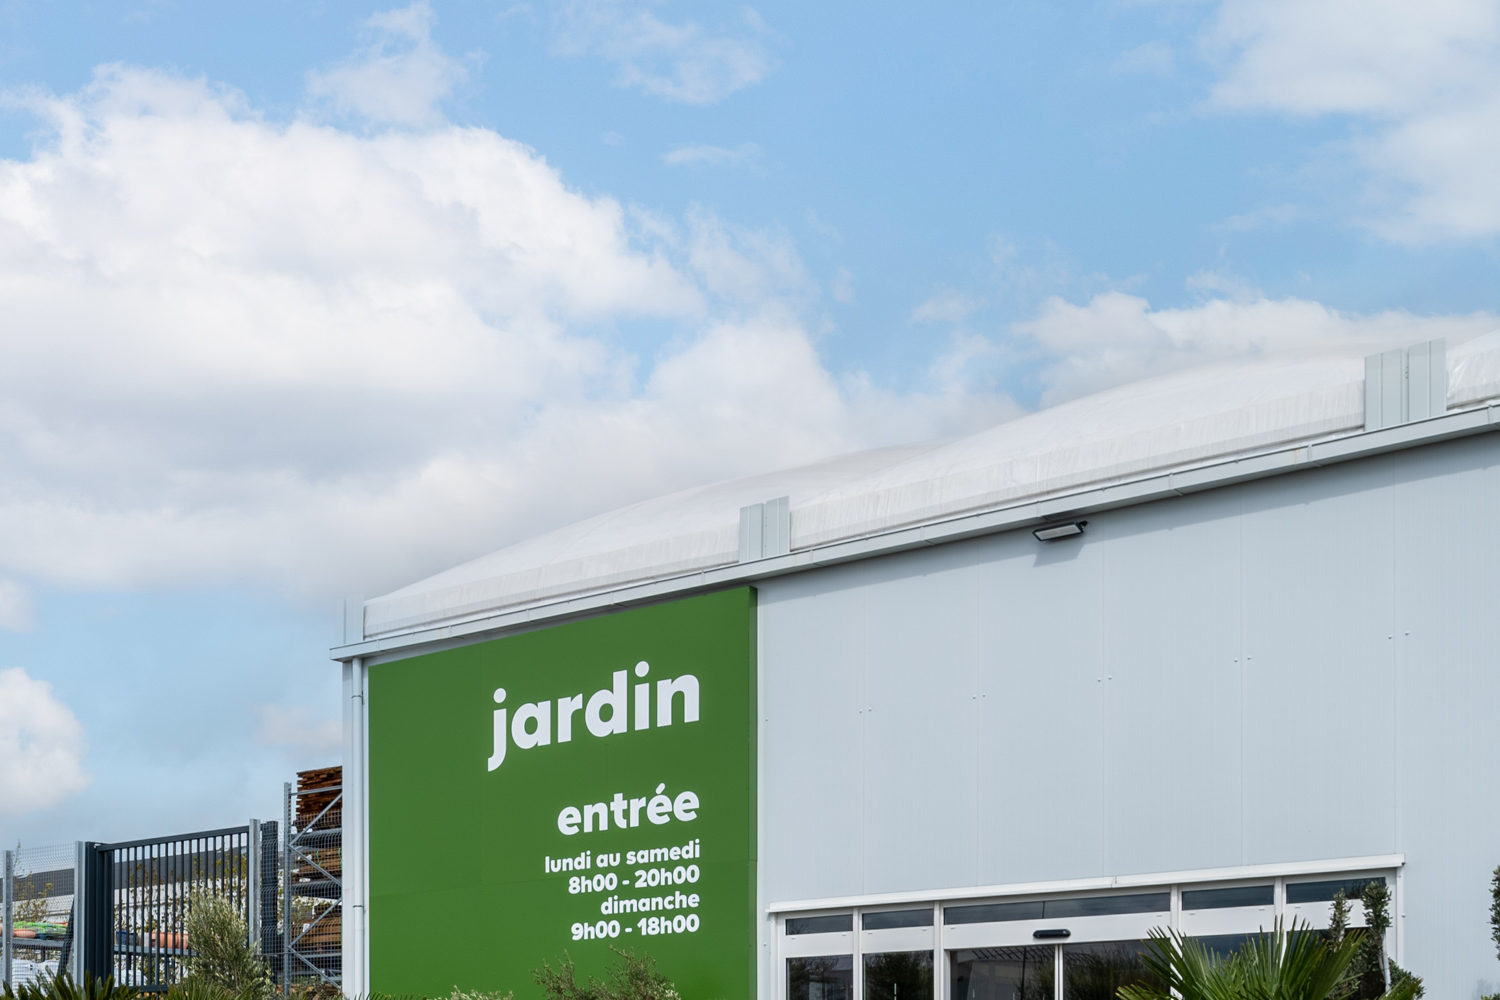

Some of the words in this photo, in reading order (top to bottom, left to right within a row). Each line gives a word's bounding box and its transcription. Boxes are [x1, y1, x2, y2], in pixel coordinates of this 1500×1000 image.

[487, 660, 700, 772] jardin
[557, 783, 700, 836] entrée
[545, 851, 591, 873] lundi
[596, 852, 621, 867] au
[626, 838, 700, 865] samedi
[568, 873, 618, 895] 8h00
[634, 864, 700, 889] 20h00
[600, 891, 700, 915] dimanche
[570, 920, 621, 941] 9h00
[636, 913, 700, 936] 18h00
